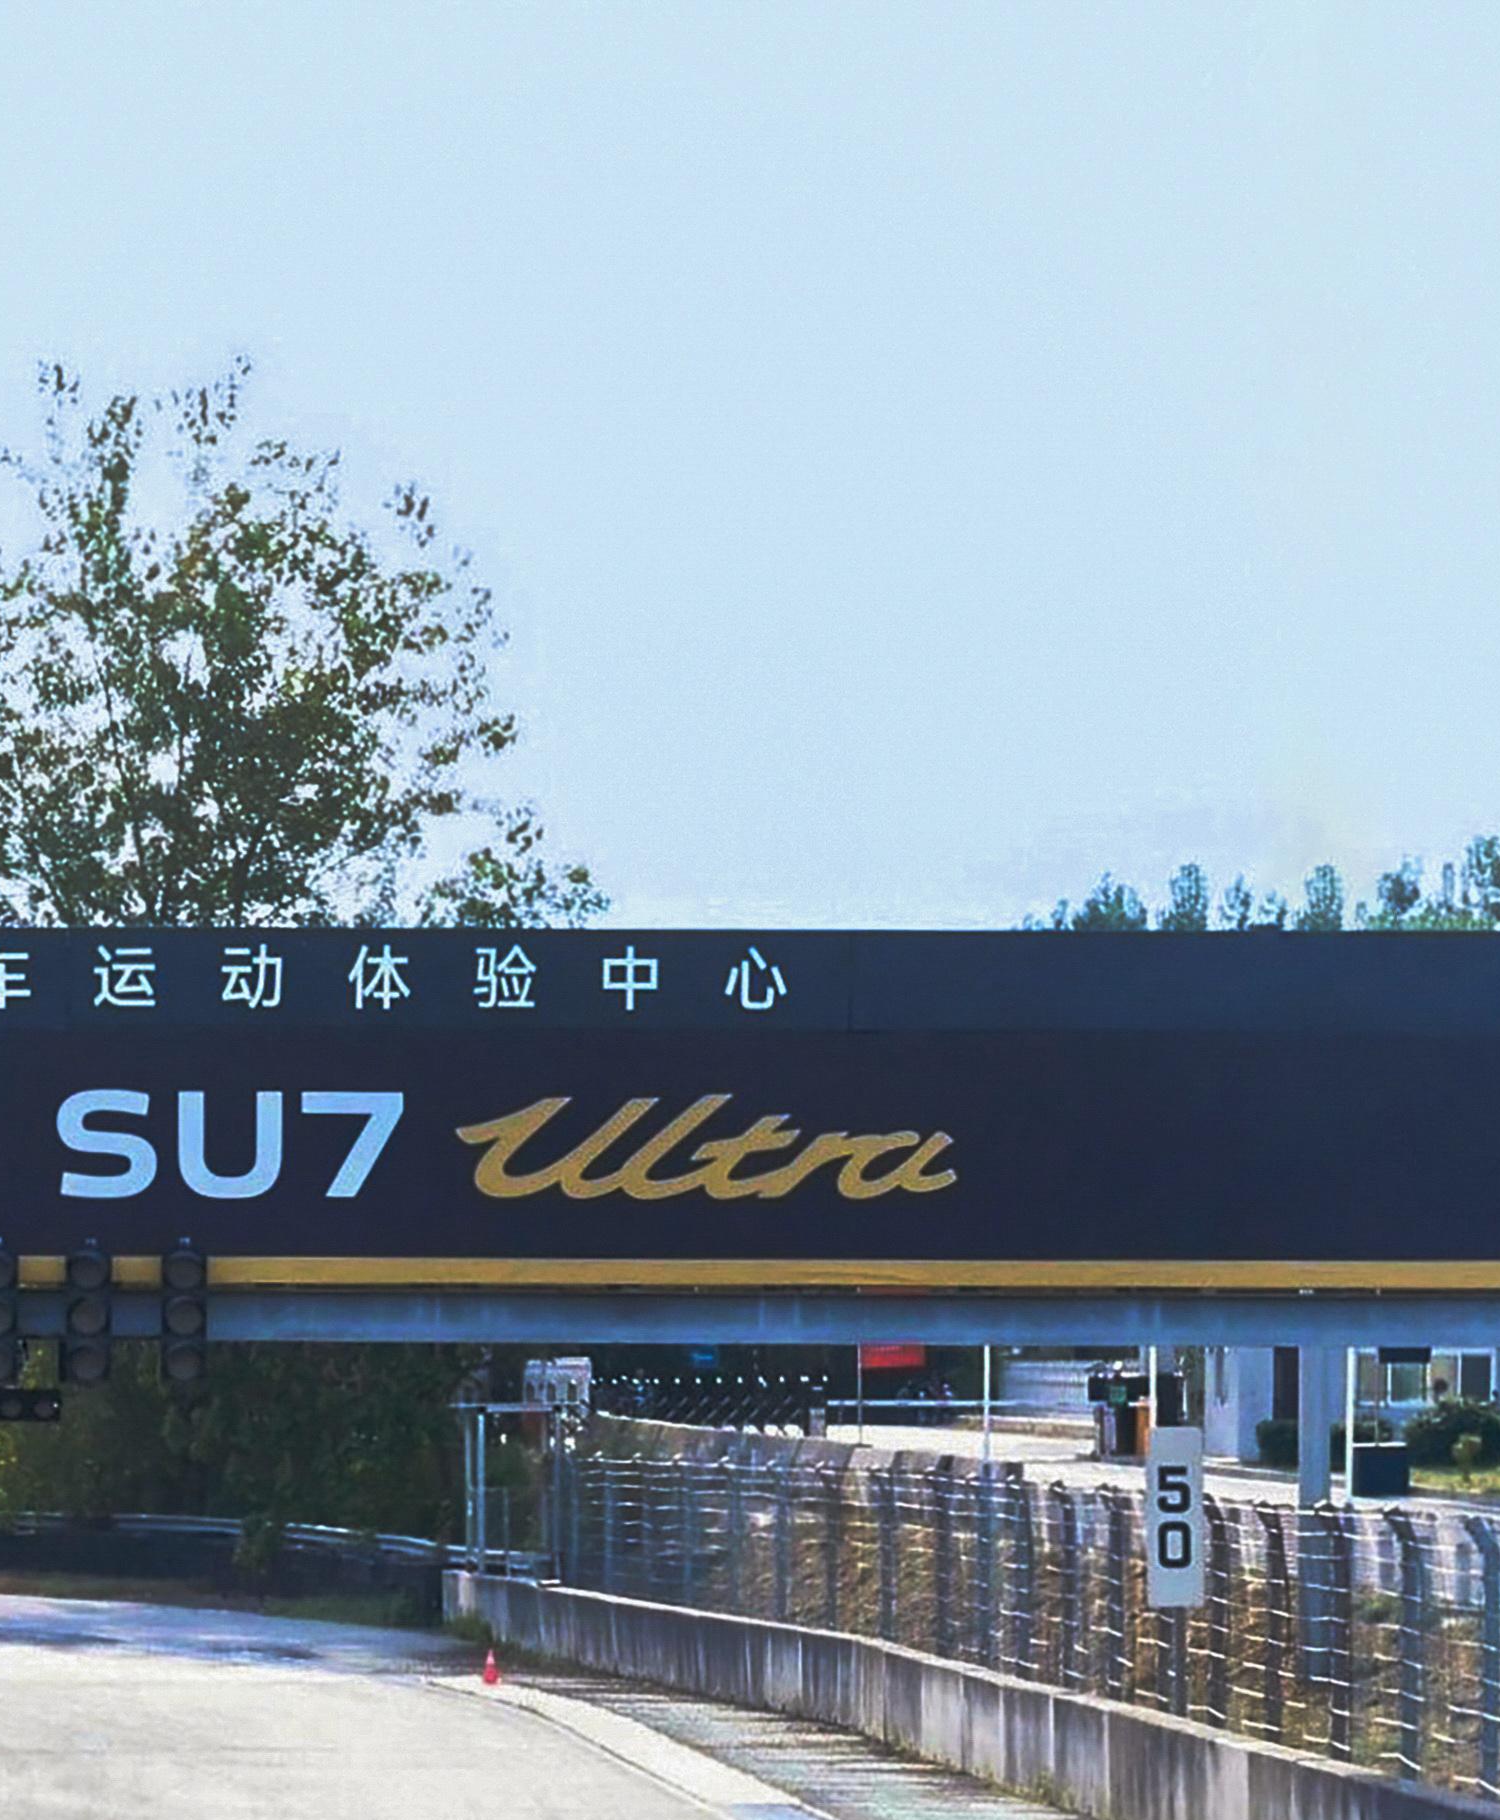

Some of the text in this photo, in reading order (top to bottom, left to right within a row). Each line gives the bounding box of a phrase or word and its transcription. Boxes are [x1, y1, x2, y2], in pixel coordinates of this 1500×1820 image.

[58, 1085, 406, 1202] SU7
[456, 1089, 960, 1202] Ultra
[1157, 1465, 1192, 1569] 50
